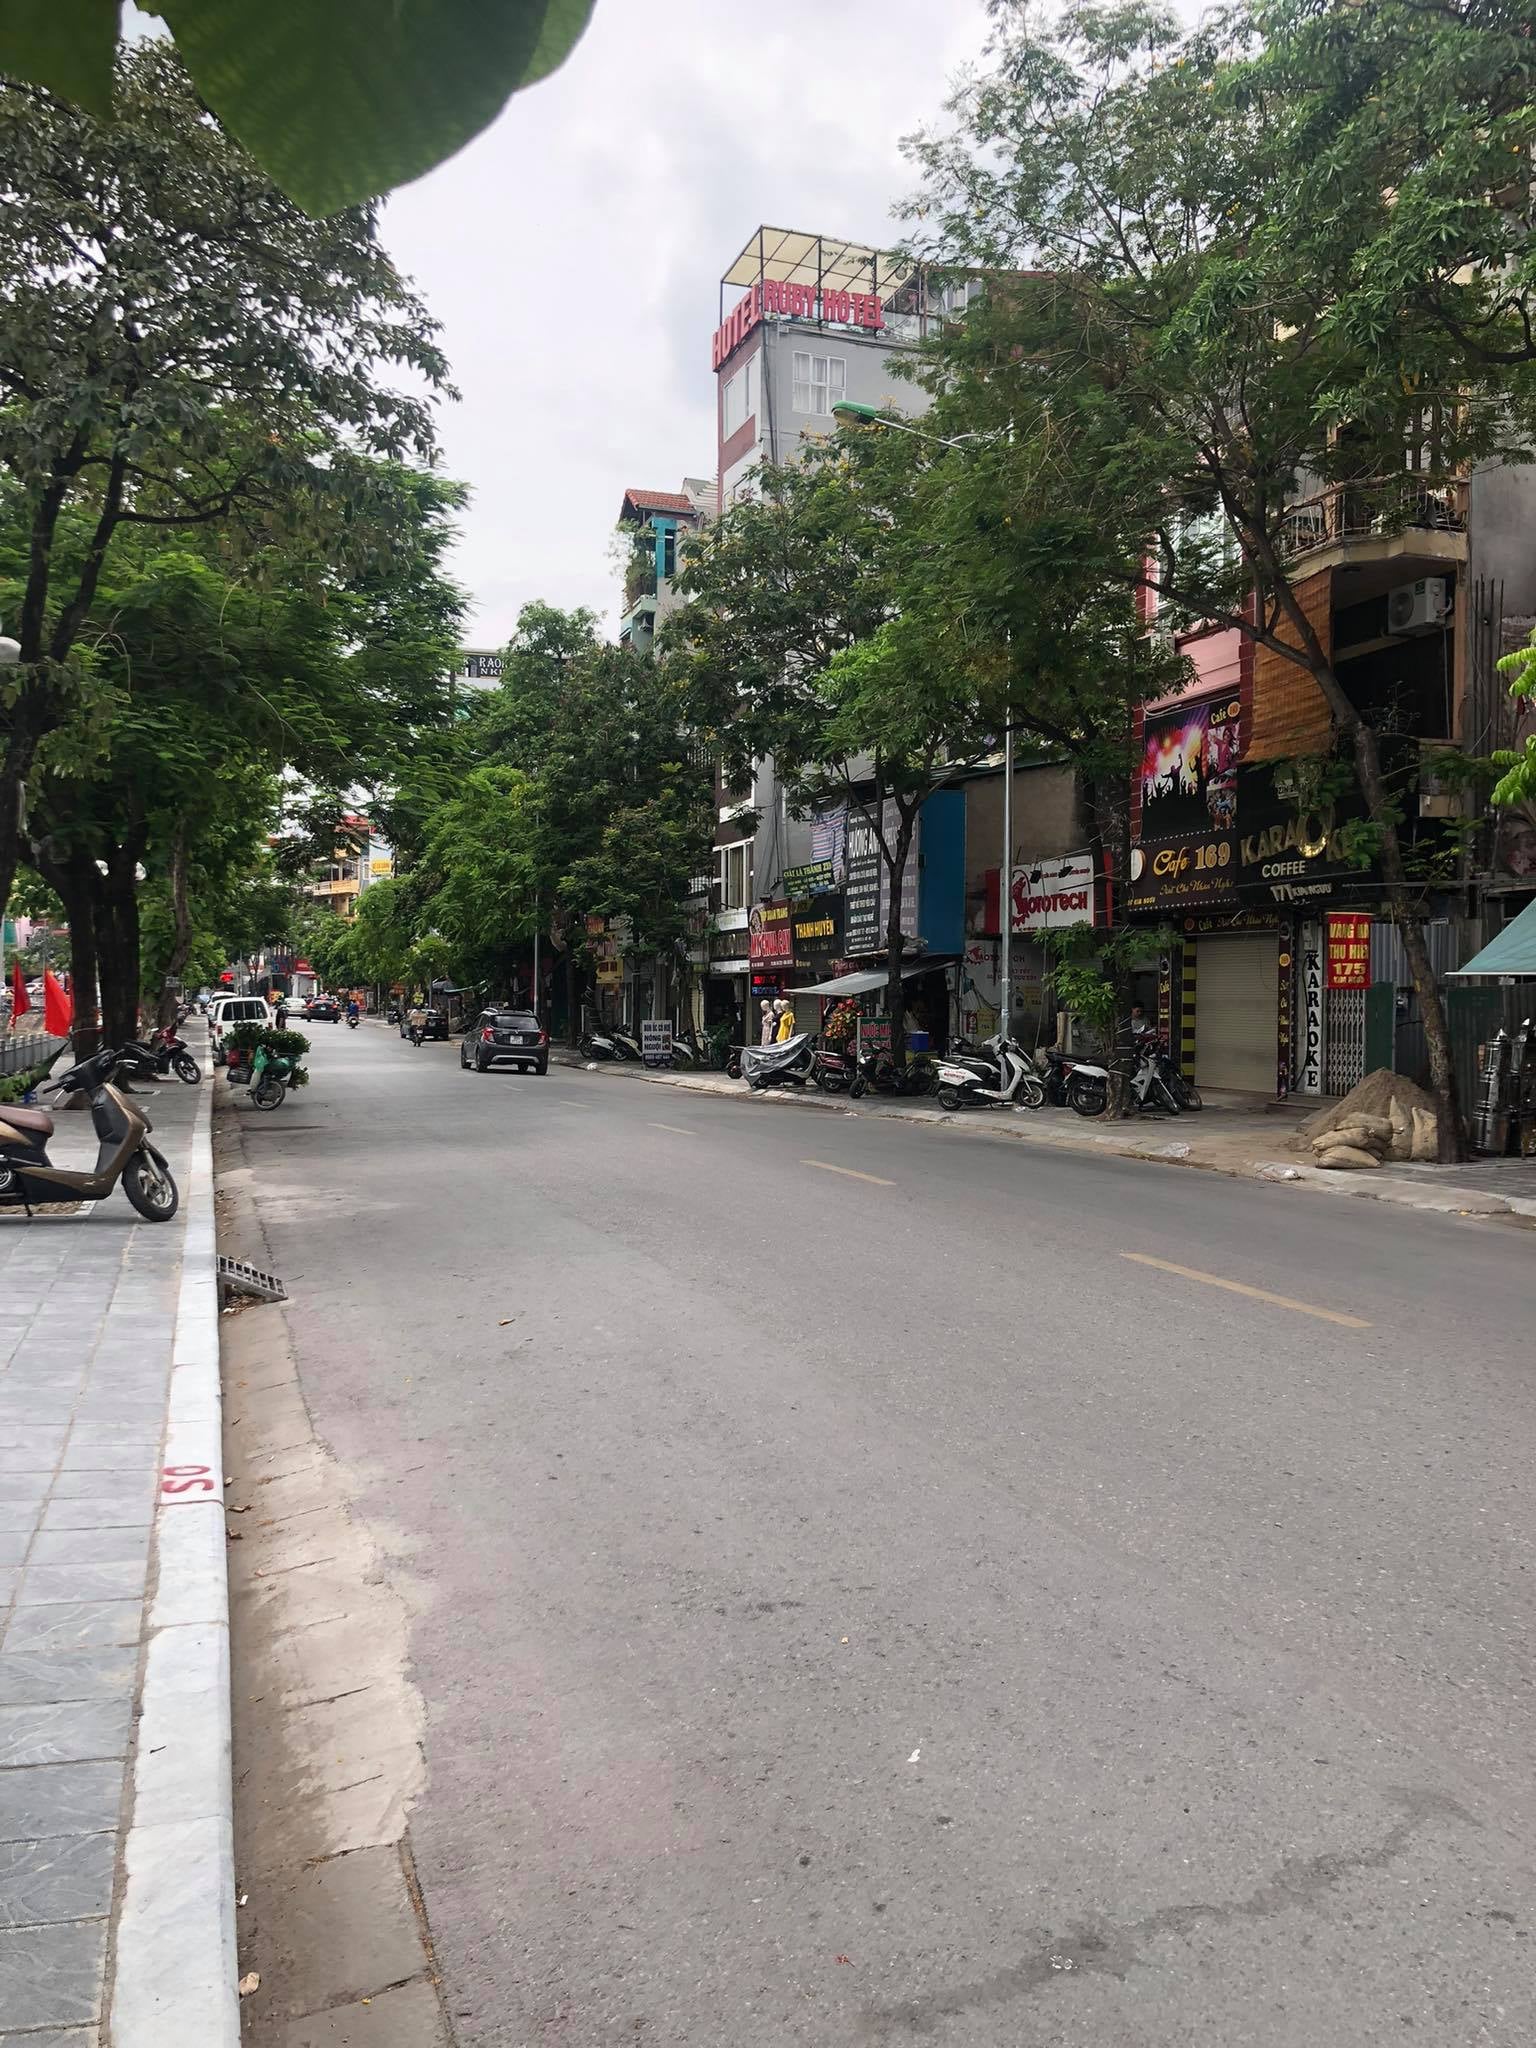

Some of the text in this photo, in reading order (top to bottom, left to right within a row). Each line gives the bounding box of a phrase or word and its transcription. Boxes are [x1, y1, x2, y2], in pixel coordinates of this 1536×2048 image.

[764, 279, 885, 329] RUBY HOTEL
[712, 284, 762, 371] HOTEL
[1195, 841, 1232, 870] 169
[1262, 860, 1307, 878] COFFEE
[1328, 944, 1347, 960] THU
[1333, 962, 1366, 975] 175
[1306, 954, 1321, 1088] KARAOKE
